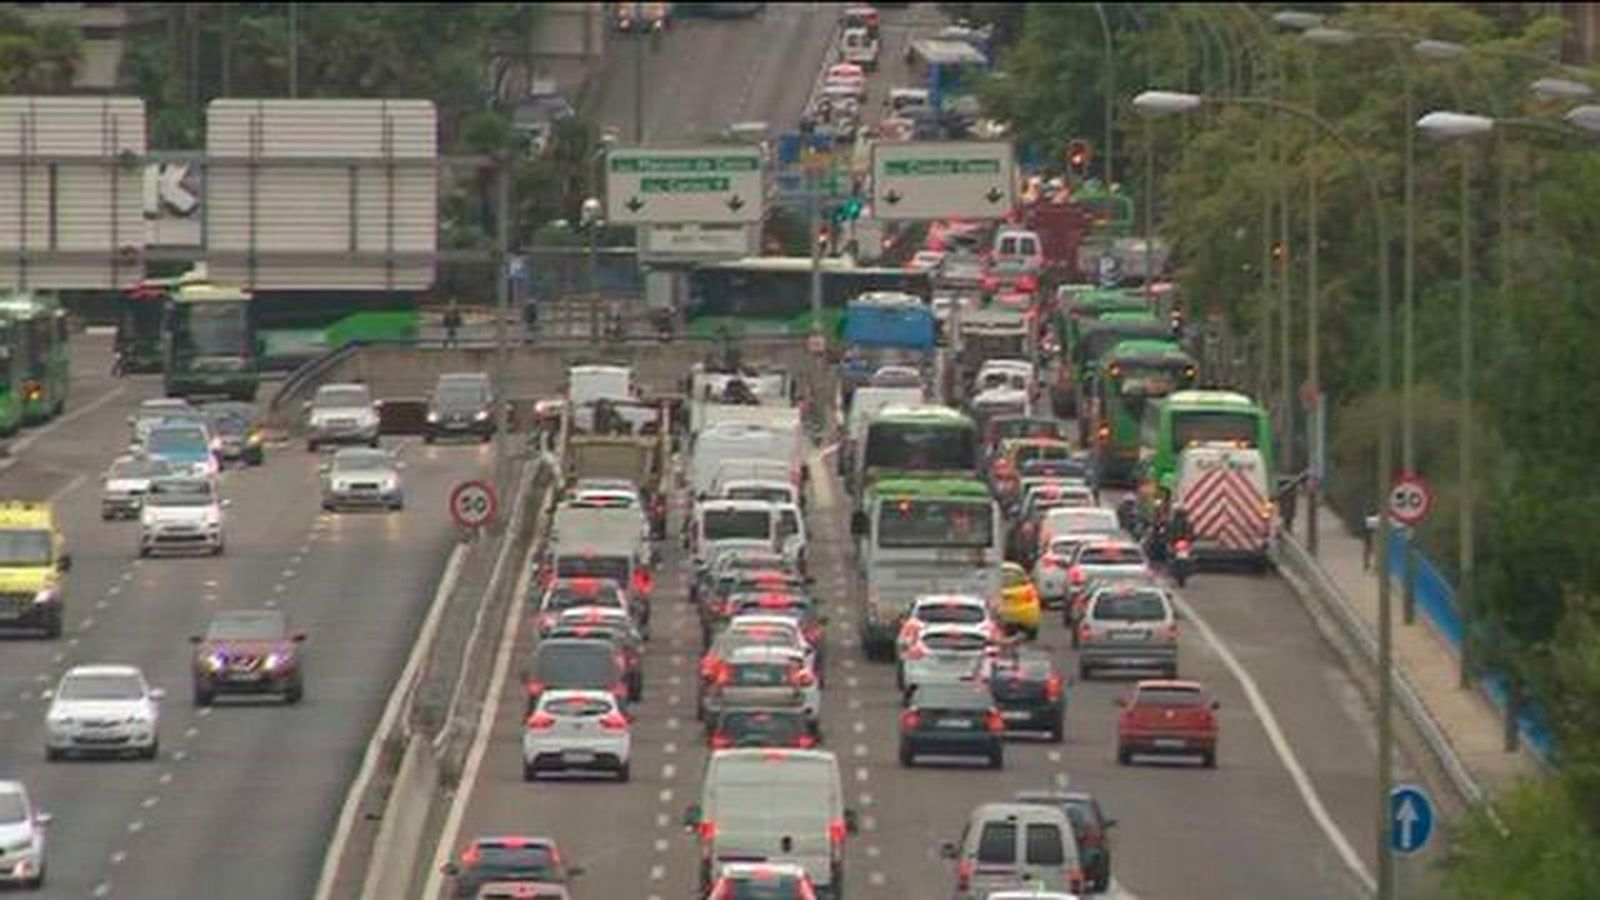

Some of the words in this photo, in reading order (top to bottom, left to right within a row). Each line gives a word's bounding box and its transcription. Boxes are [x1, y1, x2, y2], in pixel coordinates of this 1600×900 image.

[143, 163, 196, 214] K
[461, 495, 487, 514] 50
[1396, 491, 1422, 510] 50
